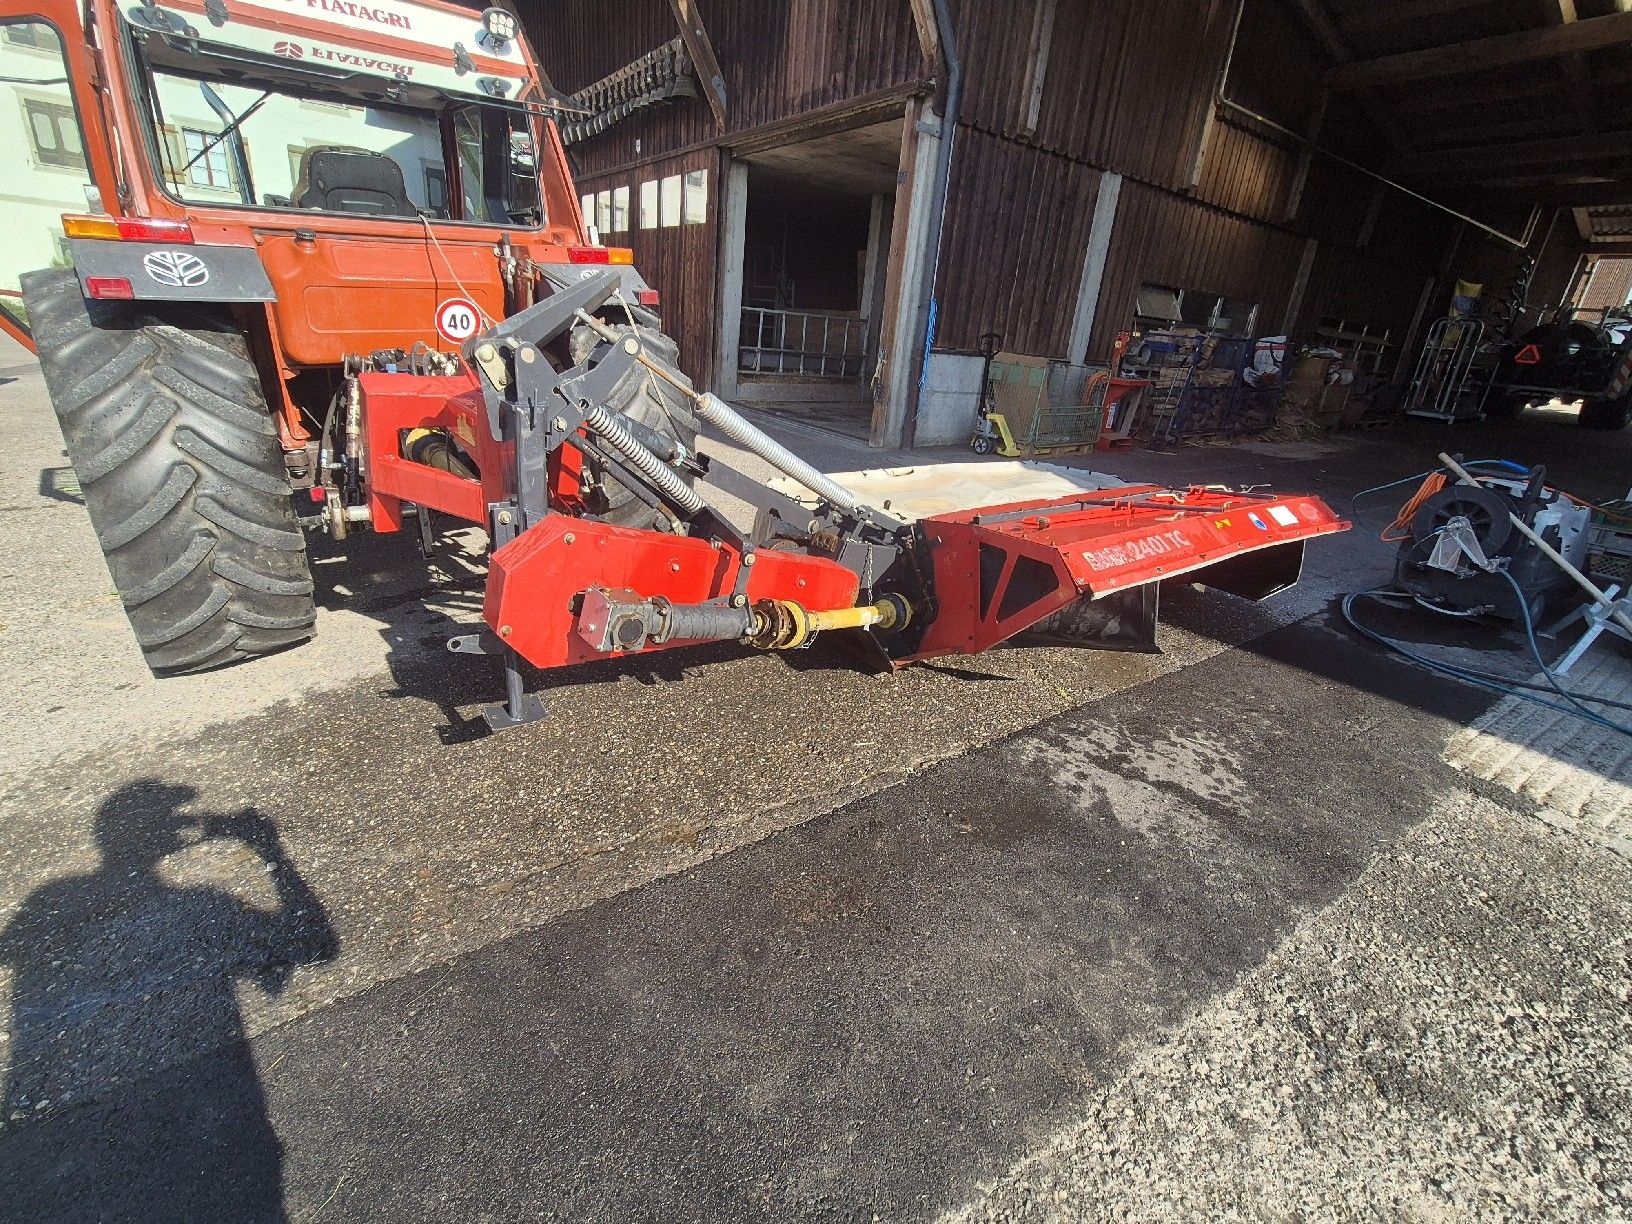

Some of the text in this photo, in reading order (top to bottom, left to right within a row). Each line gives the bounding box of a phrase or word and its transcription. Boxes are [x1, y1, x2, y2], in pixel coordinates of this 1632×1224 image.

[448, 313, 470, 330] 40
[1126, 535, 1171, 560] 2401
[1165, 529, 1191, 548] TC
